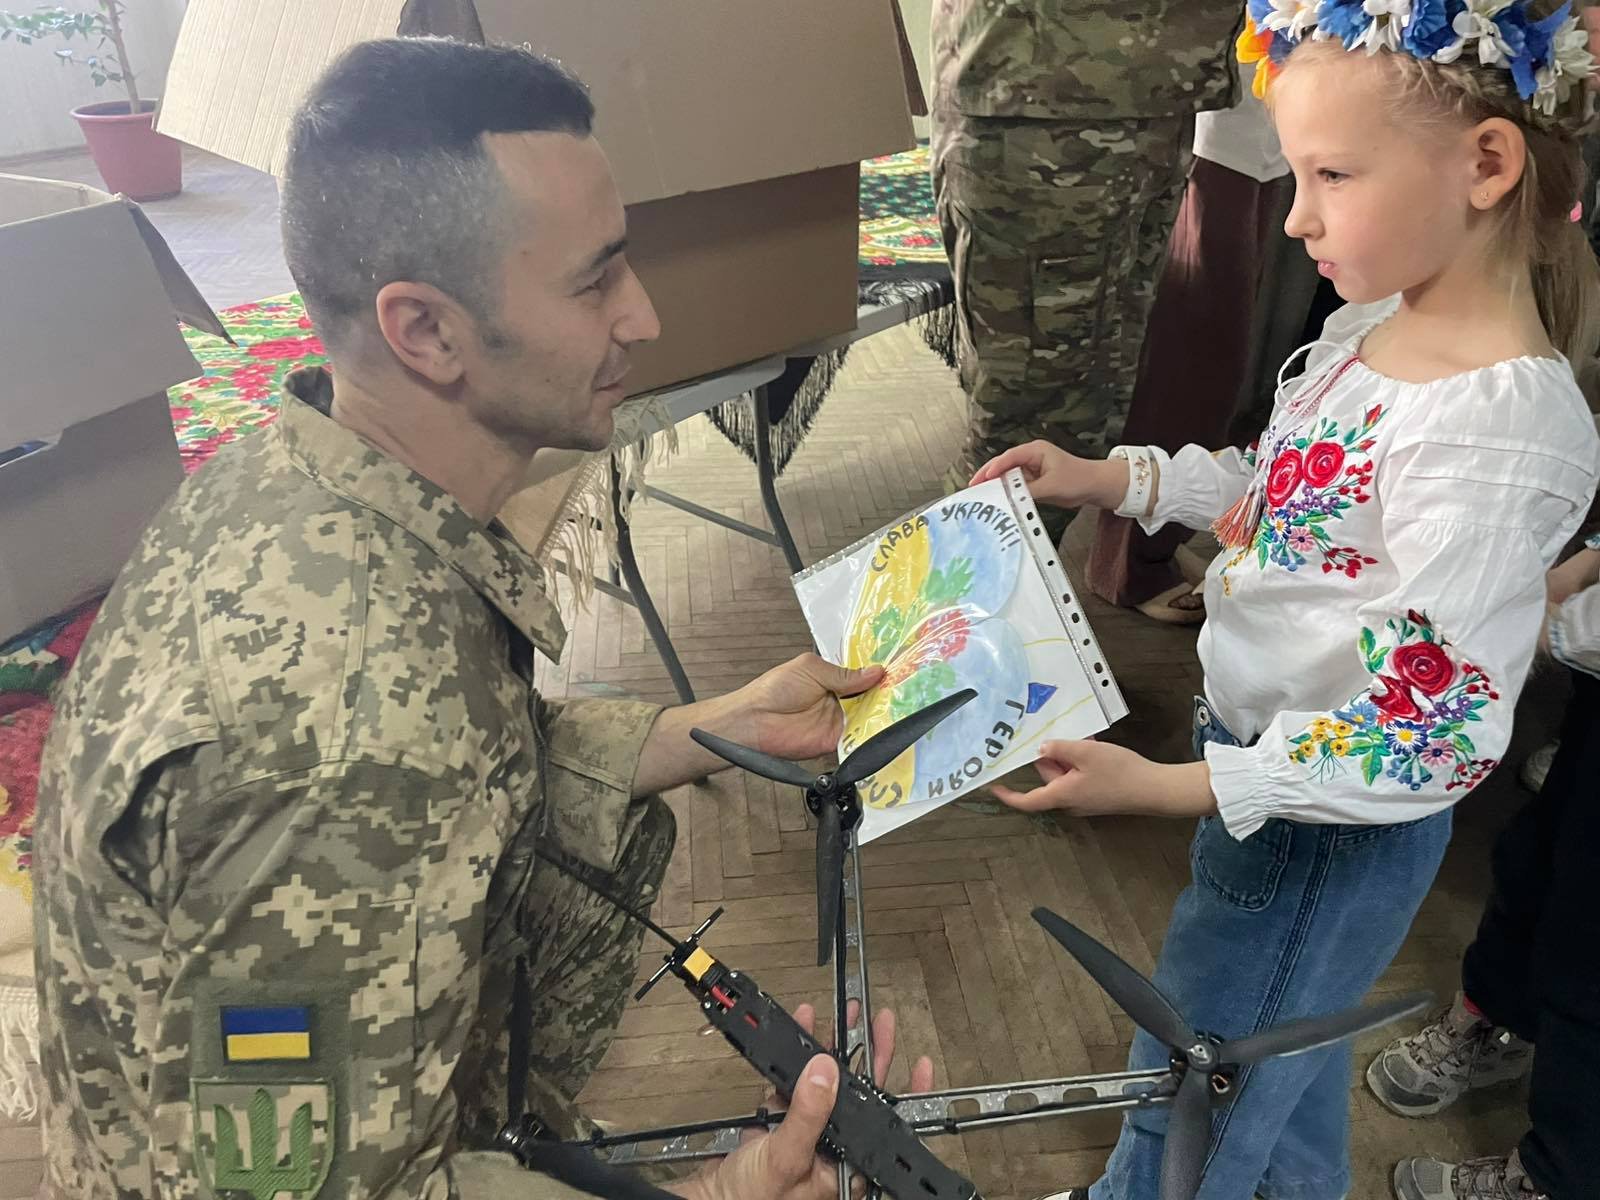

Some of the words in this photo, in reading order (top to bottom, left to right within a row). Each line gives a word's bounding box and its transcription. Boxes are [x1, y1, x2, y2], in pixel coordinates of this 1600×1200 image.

[871, 515, 930, 572] СЛАВА
[940, 501, 1021, 552] УКРАЇНІ!
[928, 700, 1025, 798] ГЕРОЯМ
